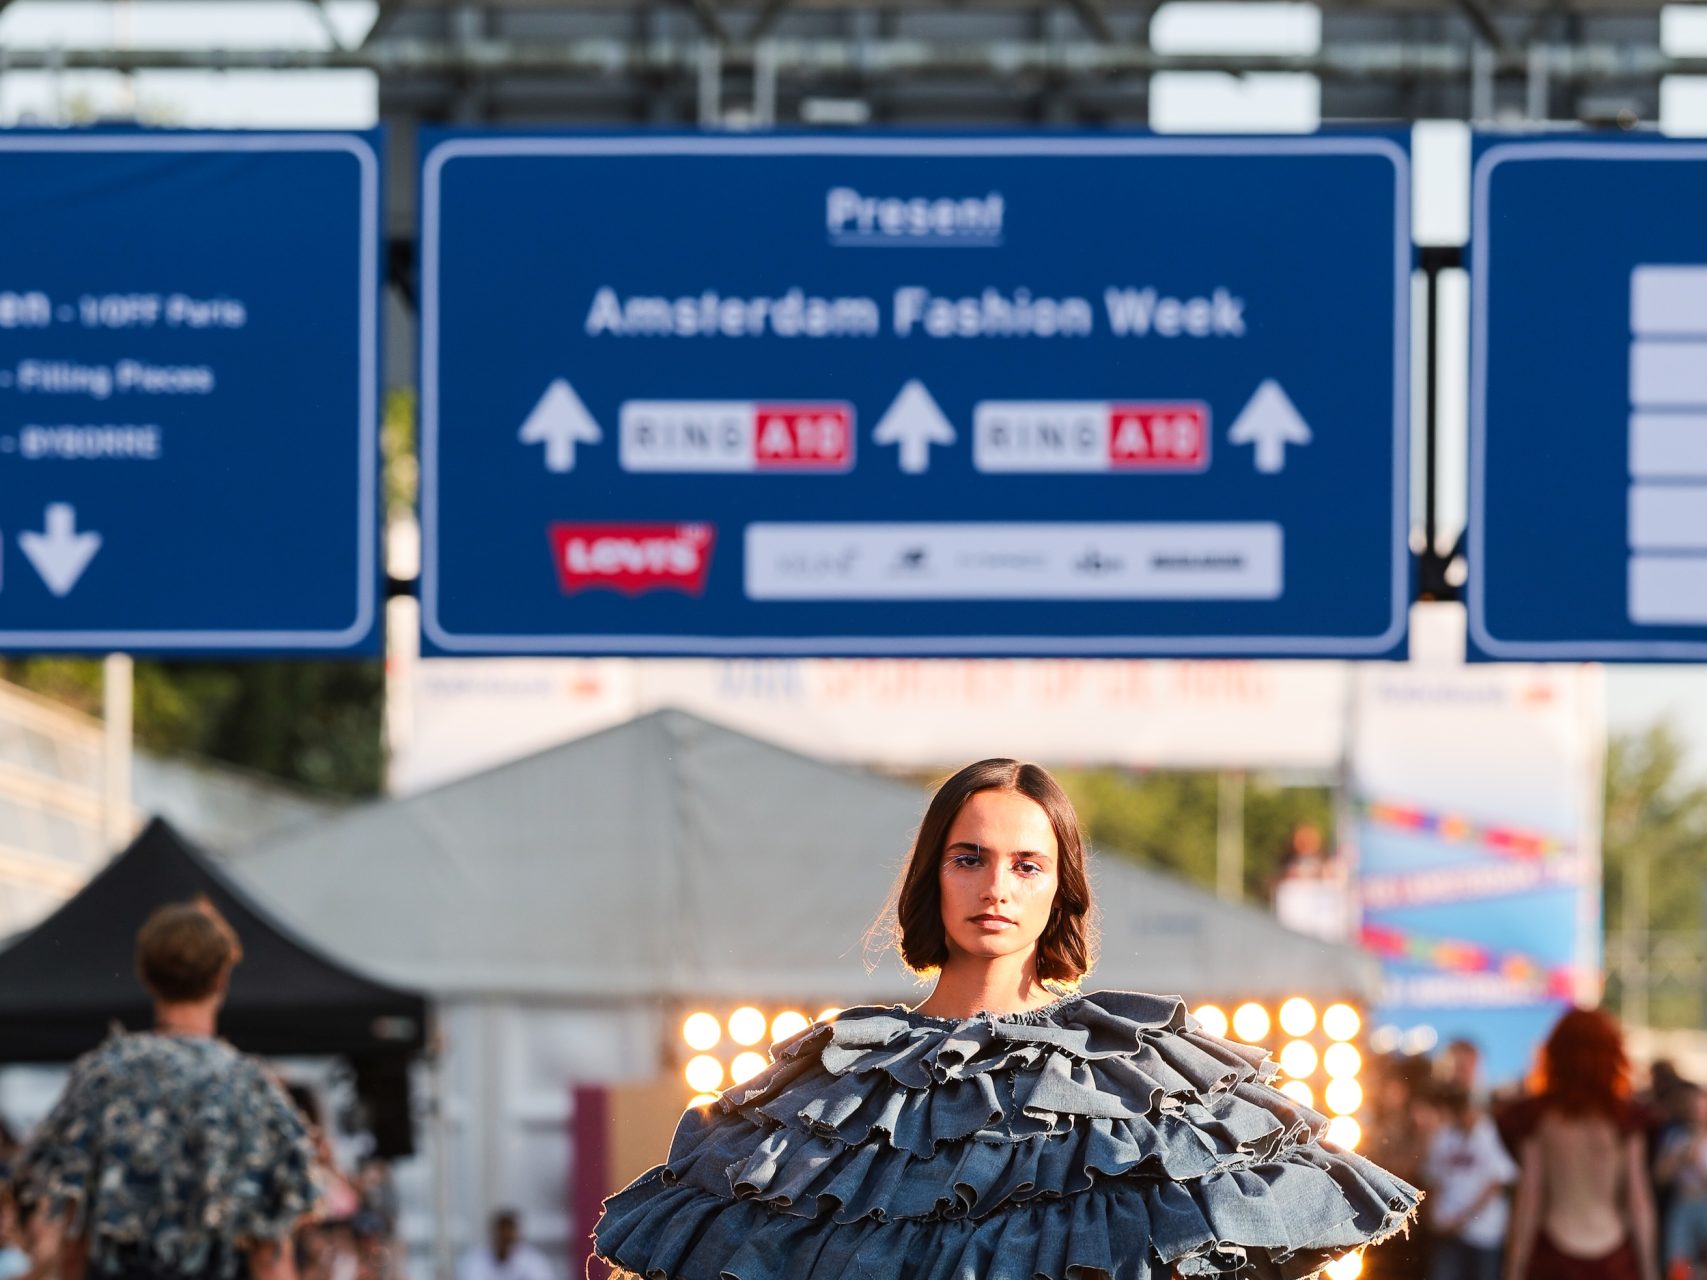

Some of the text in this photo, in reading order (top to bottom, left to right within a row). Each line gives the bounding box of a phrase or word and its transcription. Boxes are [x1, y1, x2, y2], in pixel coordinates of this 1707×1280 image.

[827, 187, 1005, 237] Present
[585, 286, 1246, 337] Amsterdam Fashion Week
[115, 358, 215, 395] Pieces
[630, 410, 847, 459] RING A10
[984, 410, 1200, 459] RING A10
